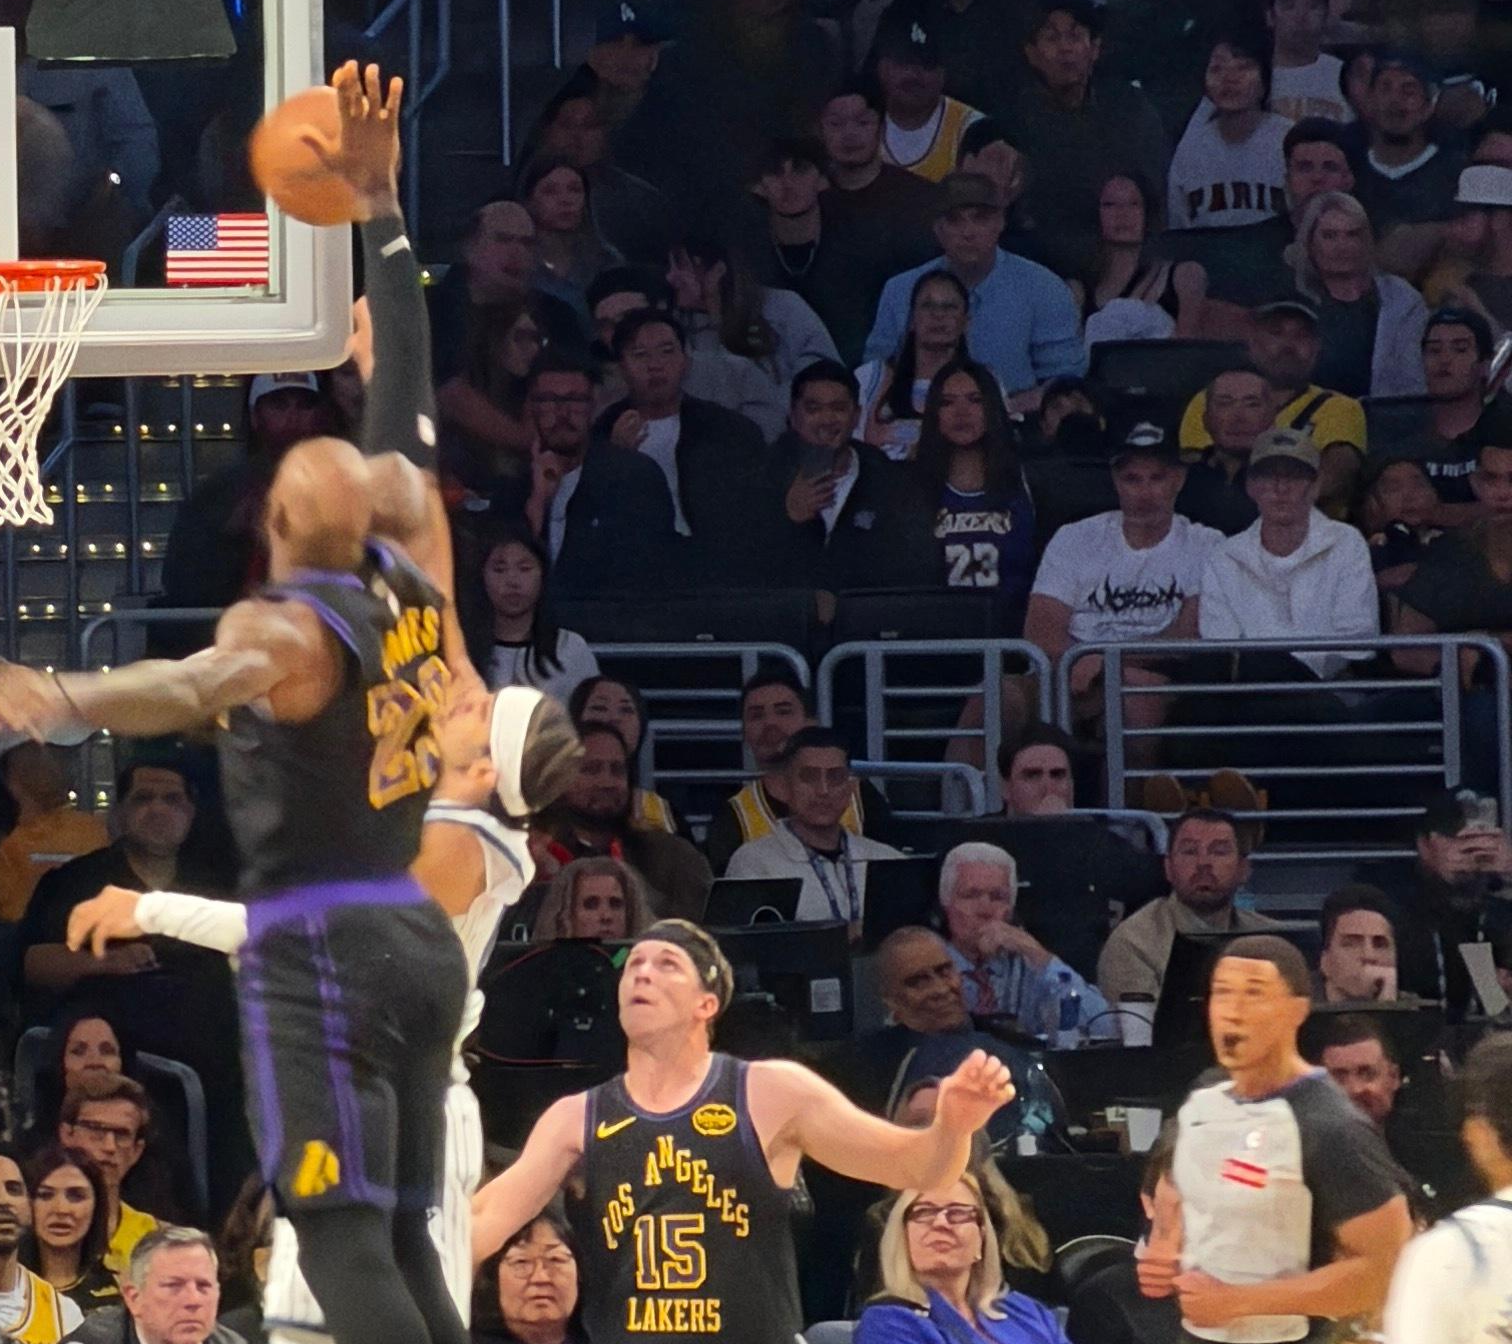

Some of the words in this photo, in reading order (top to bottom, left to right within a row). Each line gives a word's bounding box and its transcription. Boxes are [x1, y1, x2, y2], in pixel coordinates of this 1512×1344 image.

[945, 542, 999, 588] 23
[602, 1182, 636, 1250] LOS
[644, 1134, 750, 1238] ANGELES
[634, 1212, 708, 1290] 15
[626, 1296, 723, 1333] LAKERS
